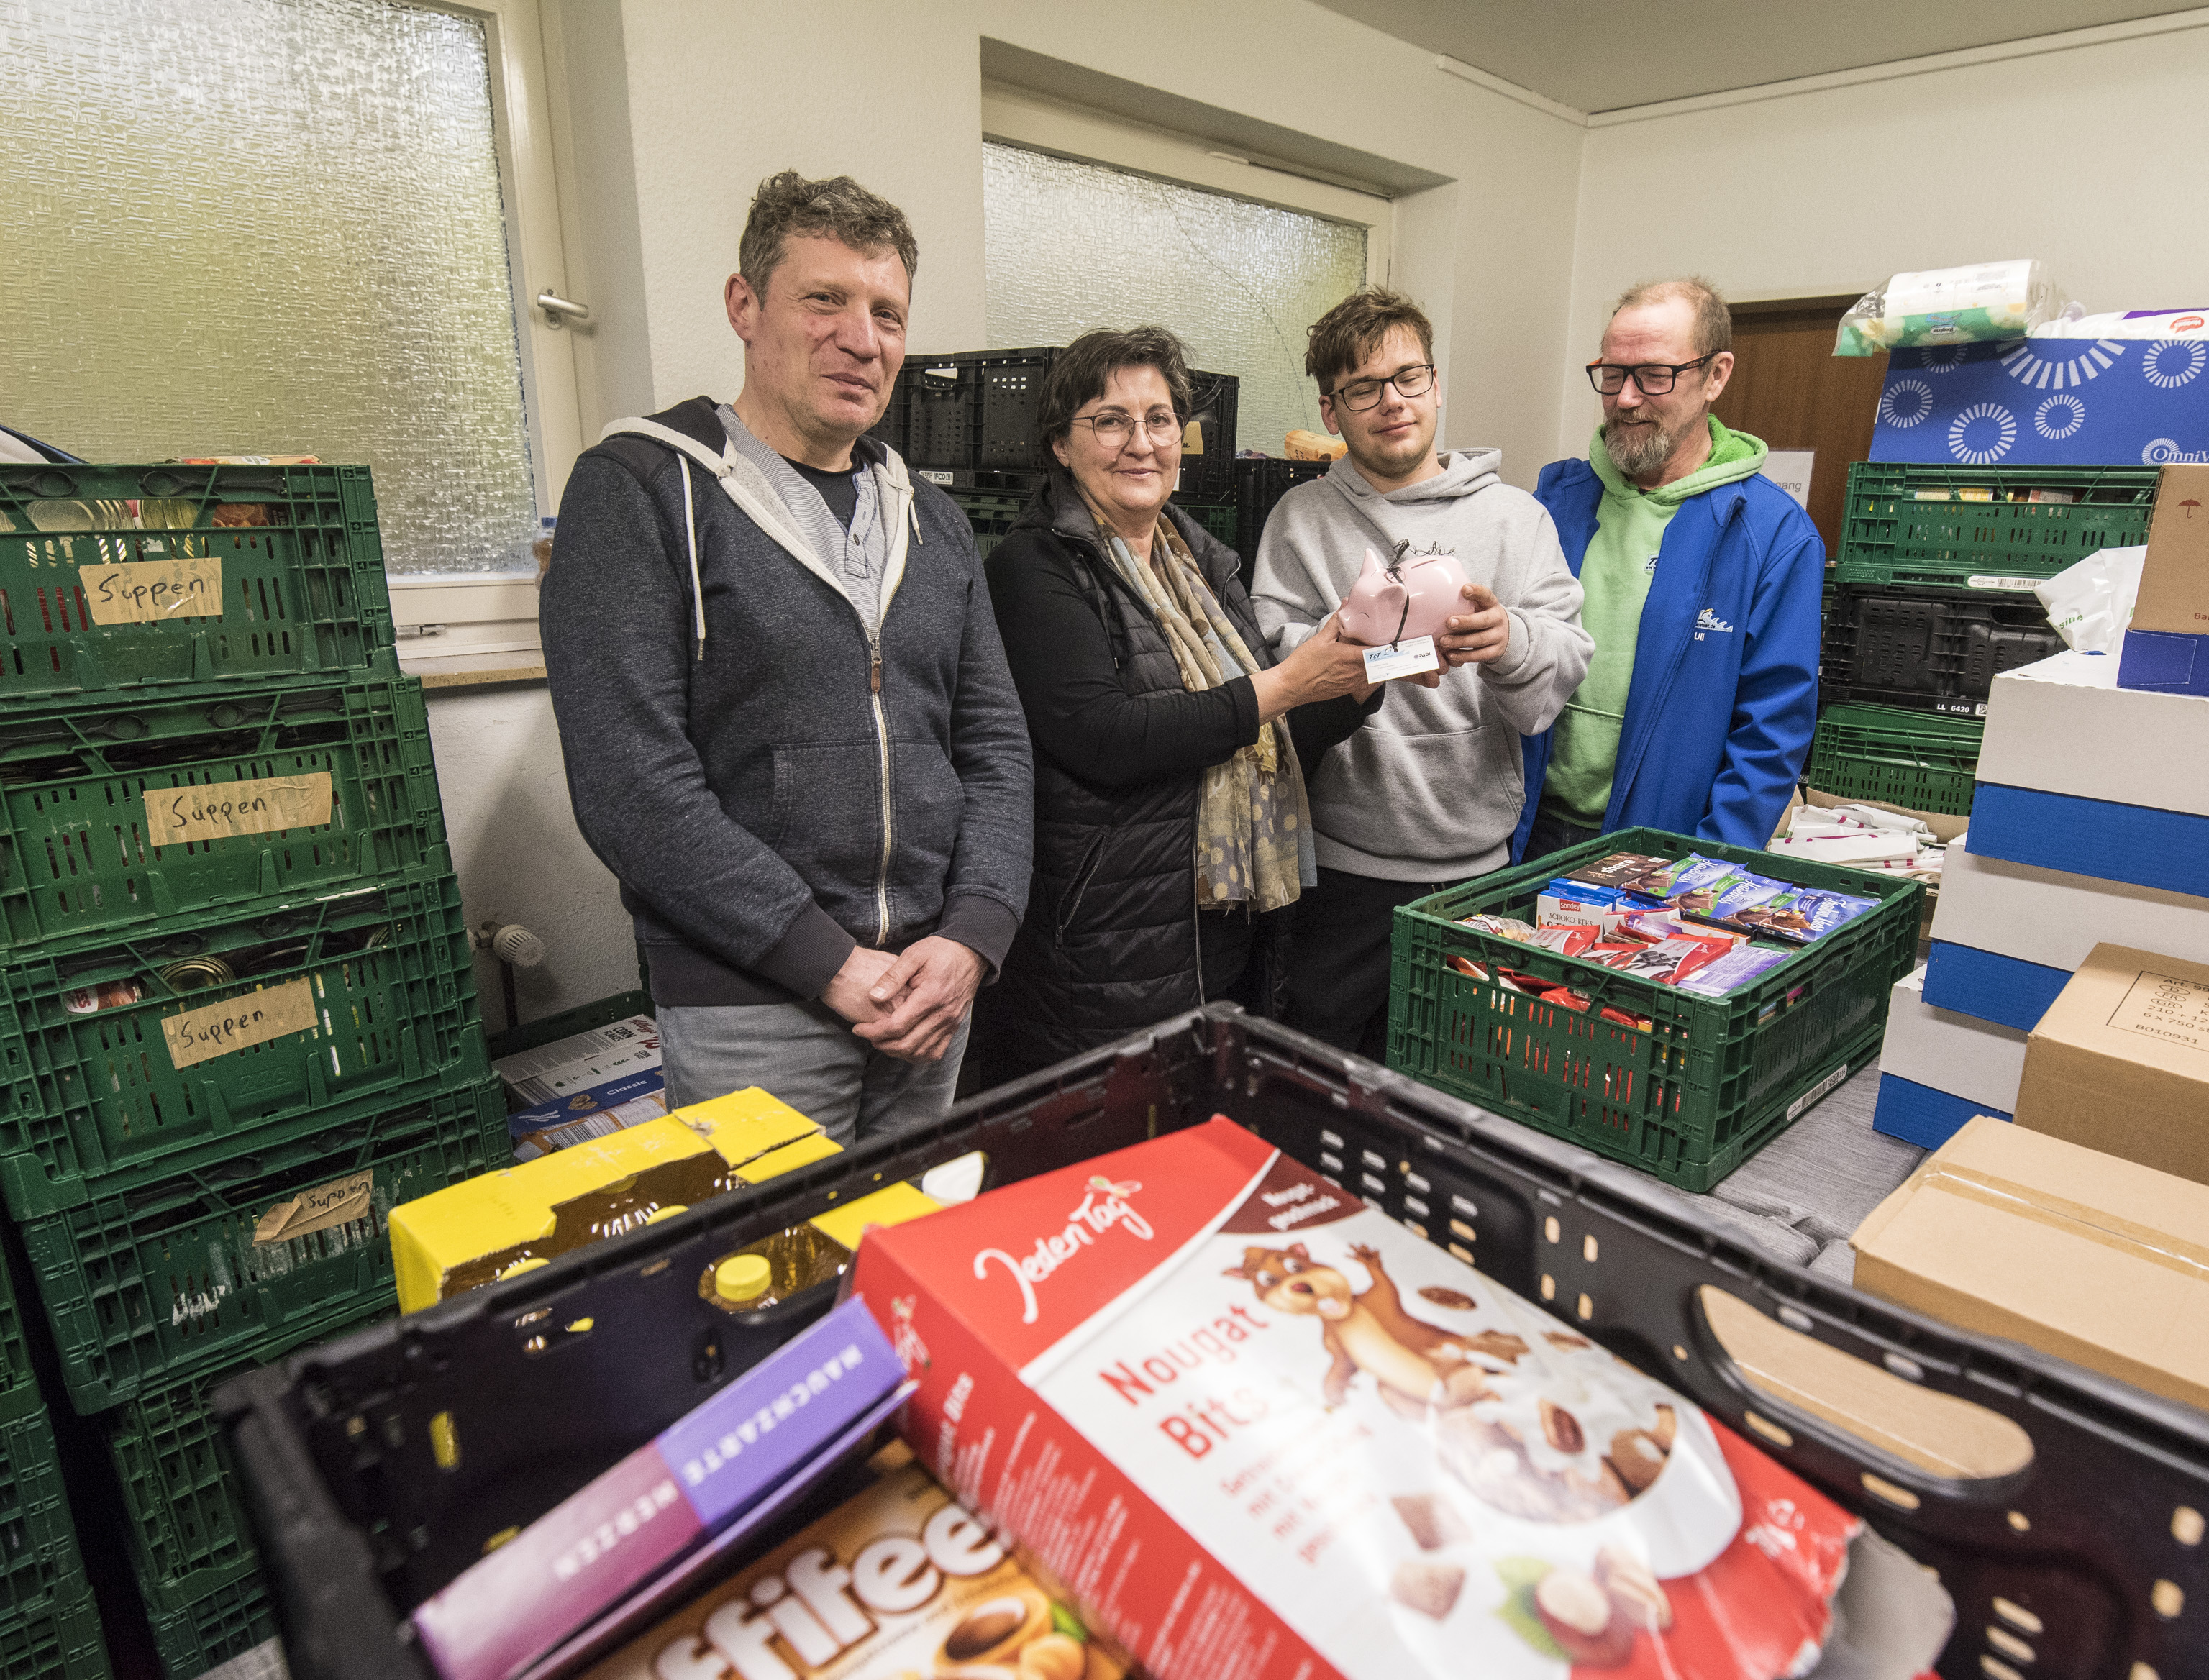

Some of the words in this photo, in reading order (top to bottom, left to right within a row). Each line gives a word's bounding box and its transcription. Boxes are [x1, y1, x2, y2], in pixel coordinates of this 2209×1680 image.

[99, 574, 204, 608] Suppen
[2194, 612, 2209, 621] Ba
[1694, 632, 1705, 641] Uli
[172, 796, 266, 827] Suppen
[1549, 912, 1593, 926] SCHOKO-KEKS
[2164, 979, 2188, 987] Art.
[2147, 1005, 2174, 1015] 210
[181, 1010, 263, 1048] Suppen
[2169, 1018, 2195, 1028] 750
[603, 1030, 624, 1042] FLAKES
[612, 1026, 637, 1039] CORN
[607, 1079, 647, 1095] Classic
[1098, 1300, 1270, 1407] Nougat
[1157, 1384, 1272, 1461] Bits
[552, 1479, 679, 1580] HERZEN
